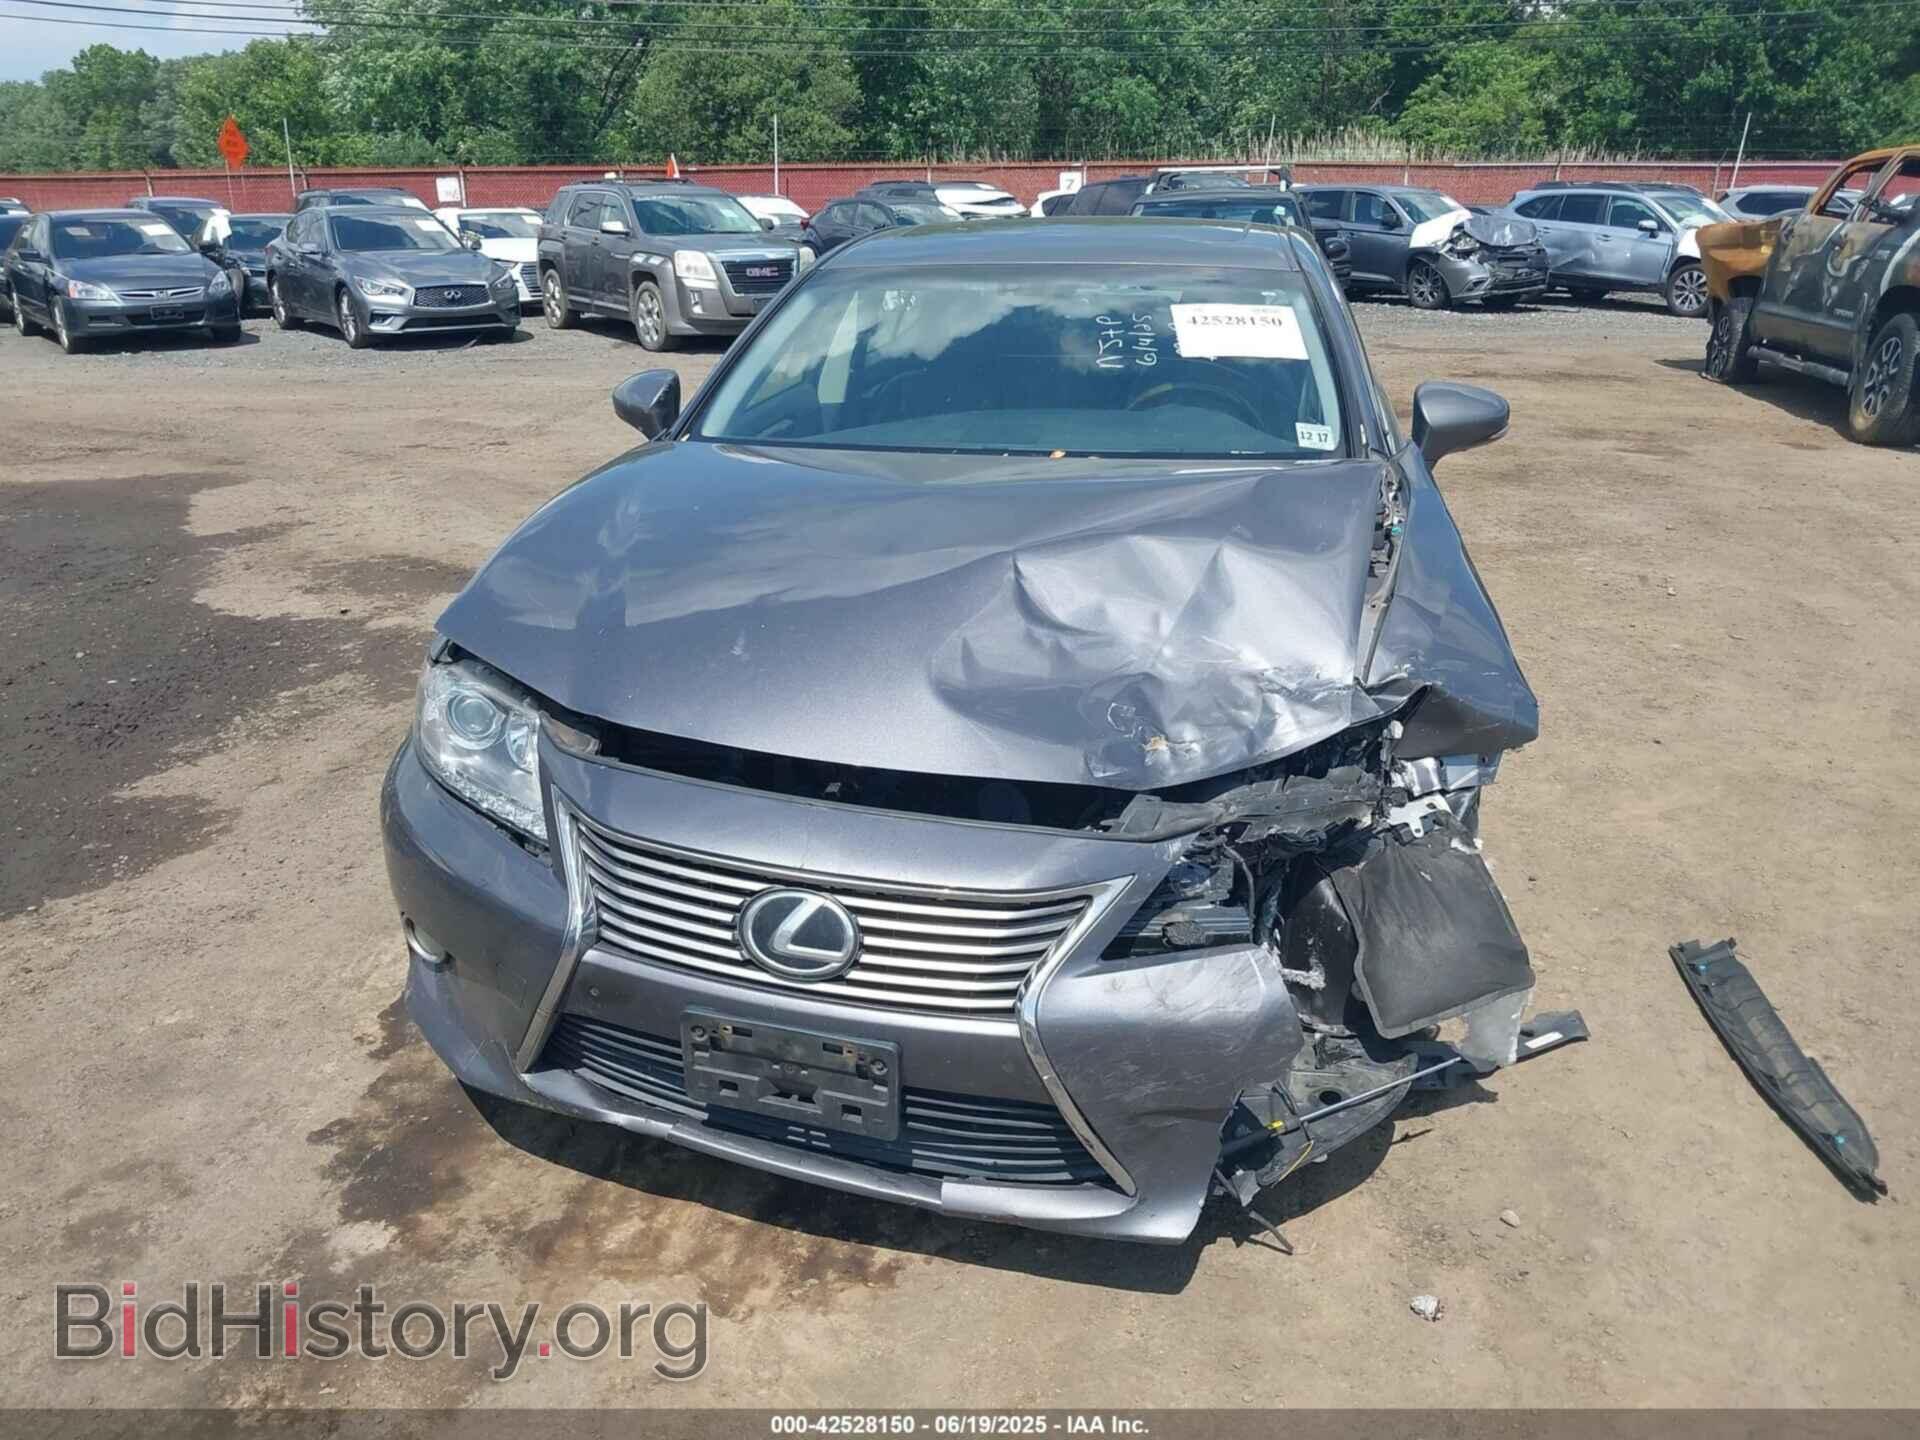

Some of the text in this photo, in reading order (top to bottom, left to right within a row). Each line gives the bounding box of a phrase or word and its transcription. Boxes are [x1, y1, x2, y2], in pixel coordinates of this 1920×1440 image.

[1064, 178, 1075, 190] 7
[746, 267, 779, 277] GMC
[1187, 315, 1283, 328] 42528150
[1300, 431, 1328, 443] 12 17
